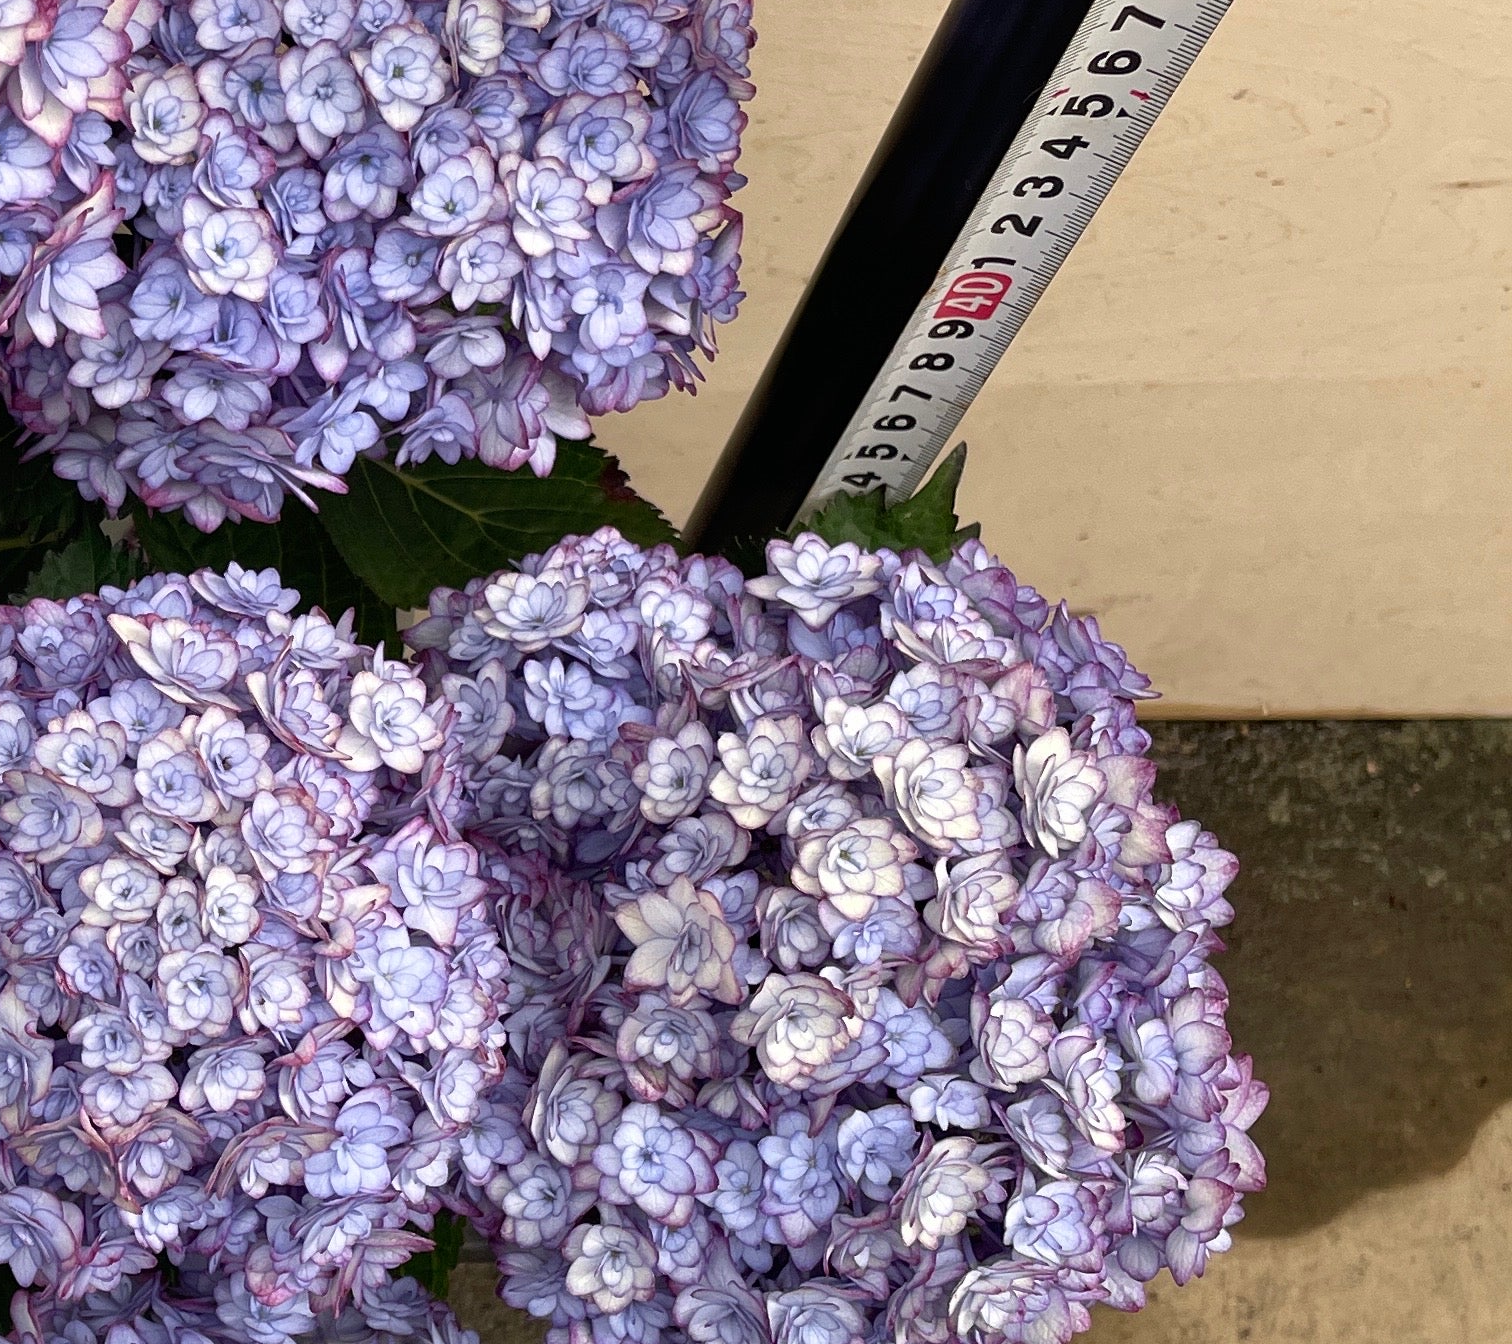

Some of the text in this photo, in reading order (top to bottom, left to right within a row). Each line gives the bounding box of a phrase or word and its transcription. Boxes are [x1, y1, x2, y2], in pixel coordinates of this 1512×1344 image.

[1110, 6, 1166, 31] 7
[1088, 51, 1142, 75] 6
[1061, 94, 1114, 117] 5
[1040, 135, 1090, 160] 4
[1013, 176, 1064, 198] 3
[991, 214, 1043, 237] 2
[971, 257, 1016, 269] 1
[945, 277, 1004, 313] 40
[928, 320, 974, 339] 9
[909, 353, 955, 371] 8
[889, 385, 932, 402] 7
[873, 414, 917, 431] 6
[854, 444, 898, 460] 5
[842, 471, 881, 488] 4
